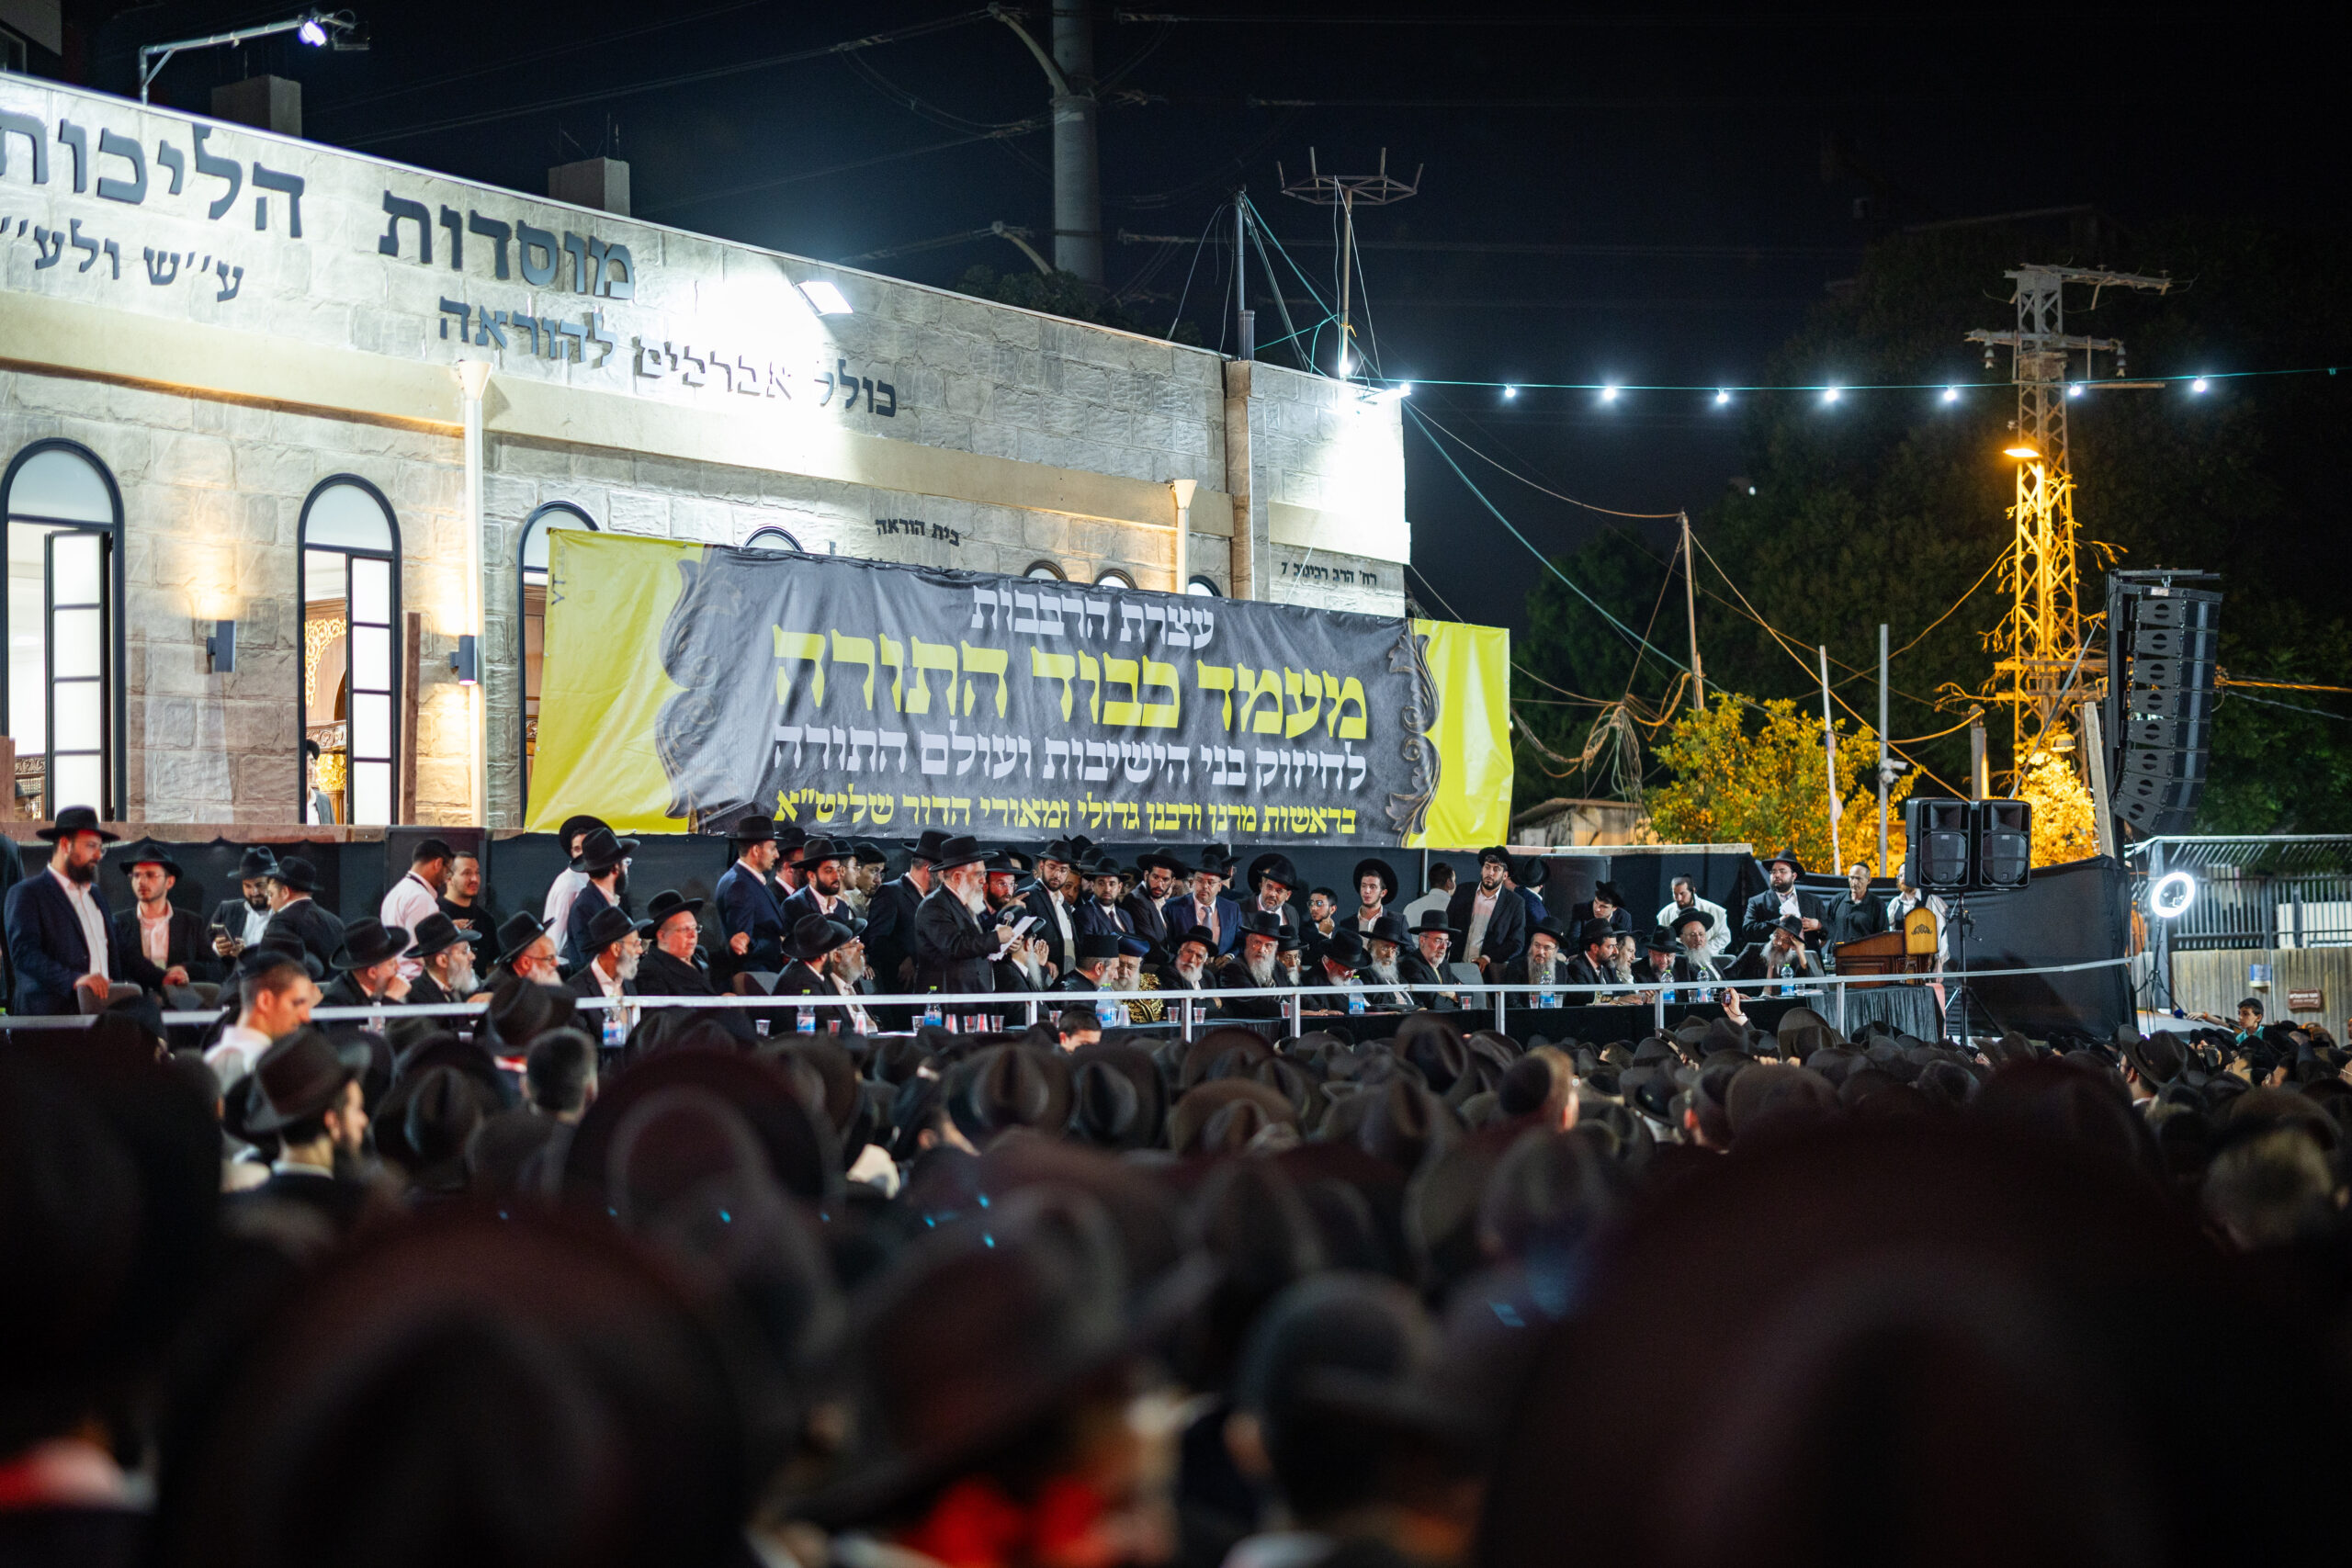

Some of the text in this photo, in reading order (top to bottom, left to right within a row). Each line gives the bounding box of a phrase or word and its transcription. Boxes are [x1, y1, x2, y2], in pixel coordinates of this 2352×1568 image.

[379, 189, 635, 300] מוסדות
[439, 295, 618, 367] להוראה
[814, 356, 897, 418] כולל
[875, 518, 960, 547] בית הוראה
[1281, 561, 1288, 575] 7
[1332, 567, 1354, 583] הרב
[1360, 570, 1377, 586] רח'
[970, 584, 1215, 650] עצרת הרבבות
[772, 624, 1368, 740] מעמד כבוד התורה
[774, 718, 1367, 793] לחיזוק בני הישיבות ועולם התורה
[902, 794, 972, 827] הדור
[979, 795, 1070, 829] ומאורי
[1078, 791, 1140, 829] גדולי
[1146, 801, 1202, 835] ורבנן
[1207, 803, 1257, 836] מרנן
[1261, 805, 1357, 835] בראשות
